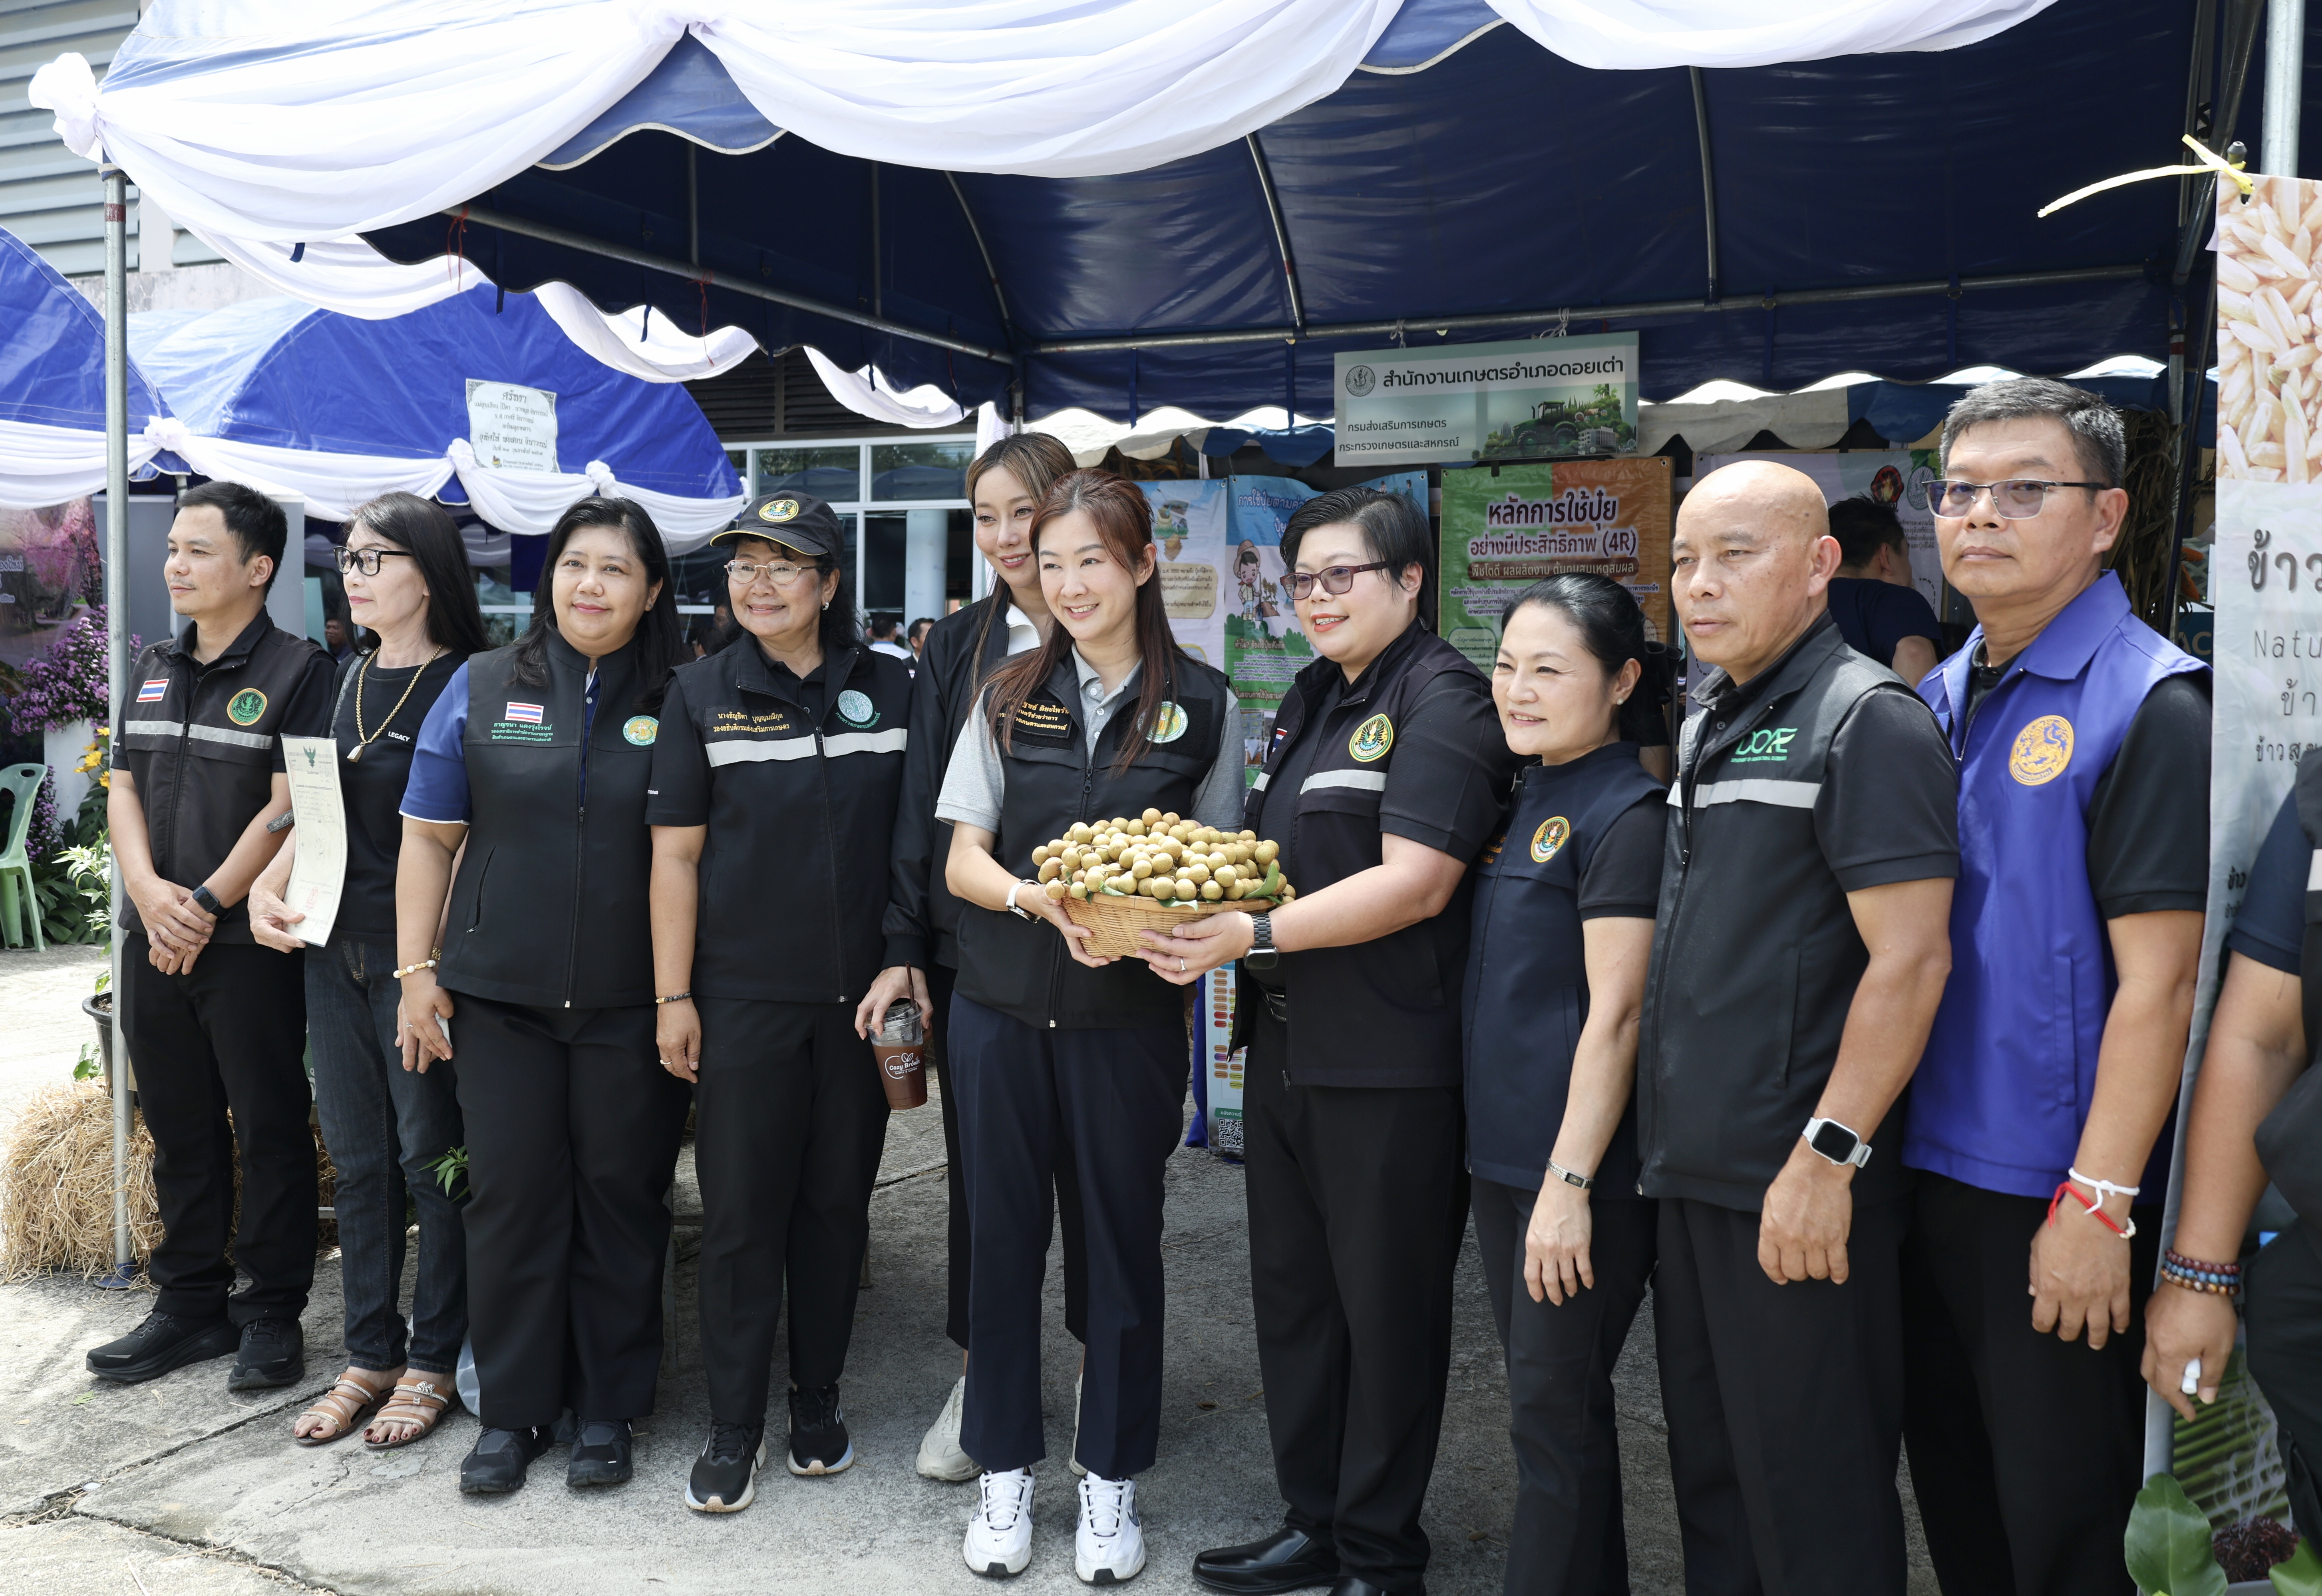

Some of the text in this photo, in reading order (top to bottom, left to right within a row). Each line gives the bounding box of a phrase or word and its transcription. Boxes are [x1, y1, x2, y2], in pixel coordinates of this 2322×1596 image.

[1383, 355, 1624, 387] สำนักงานเกษตรอำเภอดอยเต่า
[1348, 420, 1447, 432] กรมส่งเสริมการเกษตร
[1339, 437, 1459, 452] กระทรวงเกษตรและสหกรณ์
[1489, 490, 1616, 531] หลักการใช้ปุ๋ย
[1470, 530, 1636, 557] อย่างมีประสิทธิภาพ (4R)
[1472, 561, 1634, 577] พืชโตดี ผลผลิตงาม ต้นทนสมเหตุสมผล
[713, 723, 790, 733] รองอธิบดีกรมส่งเสริมการเกษตร
[388, 731, 411, 742] LEGACY
[904, 1060, 920, 1068] Brown
